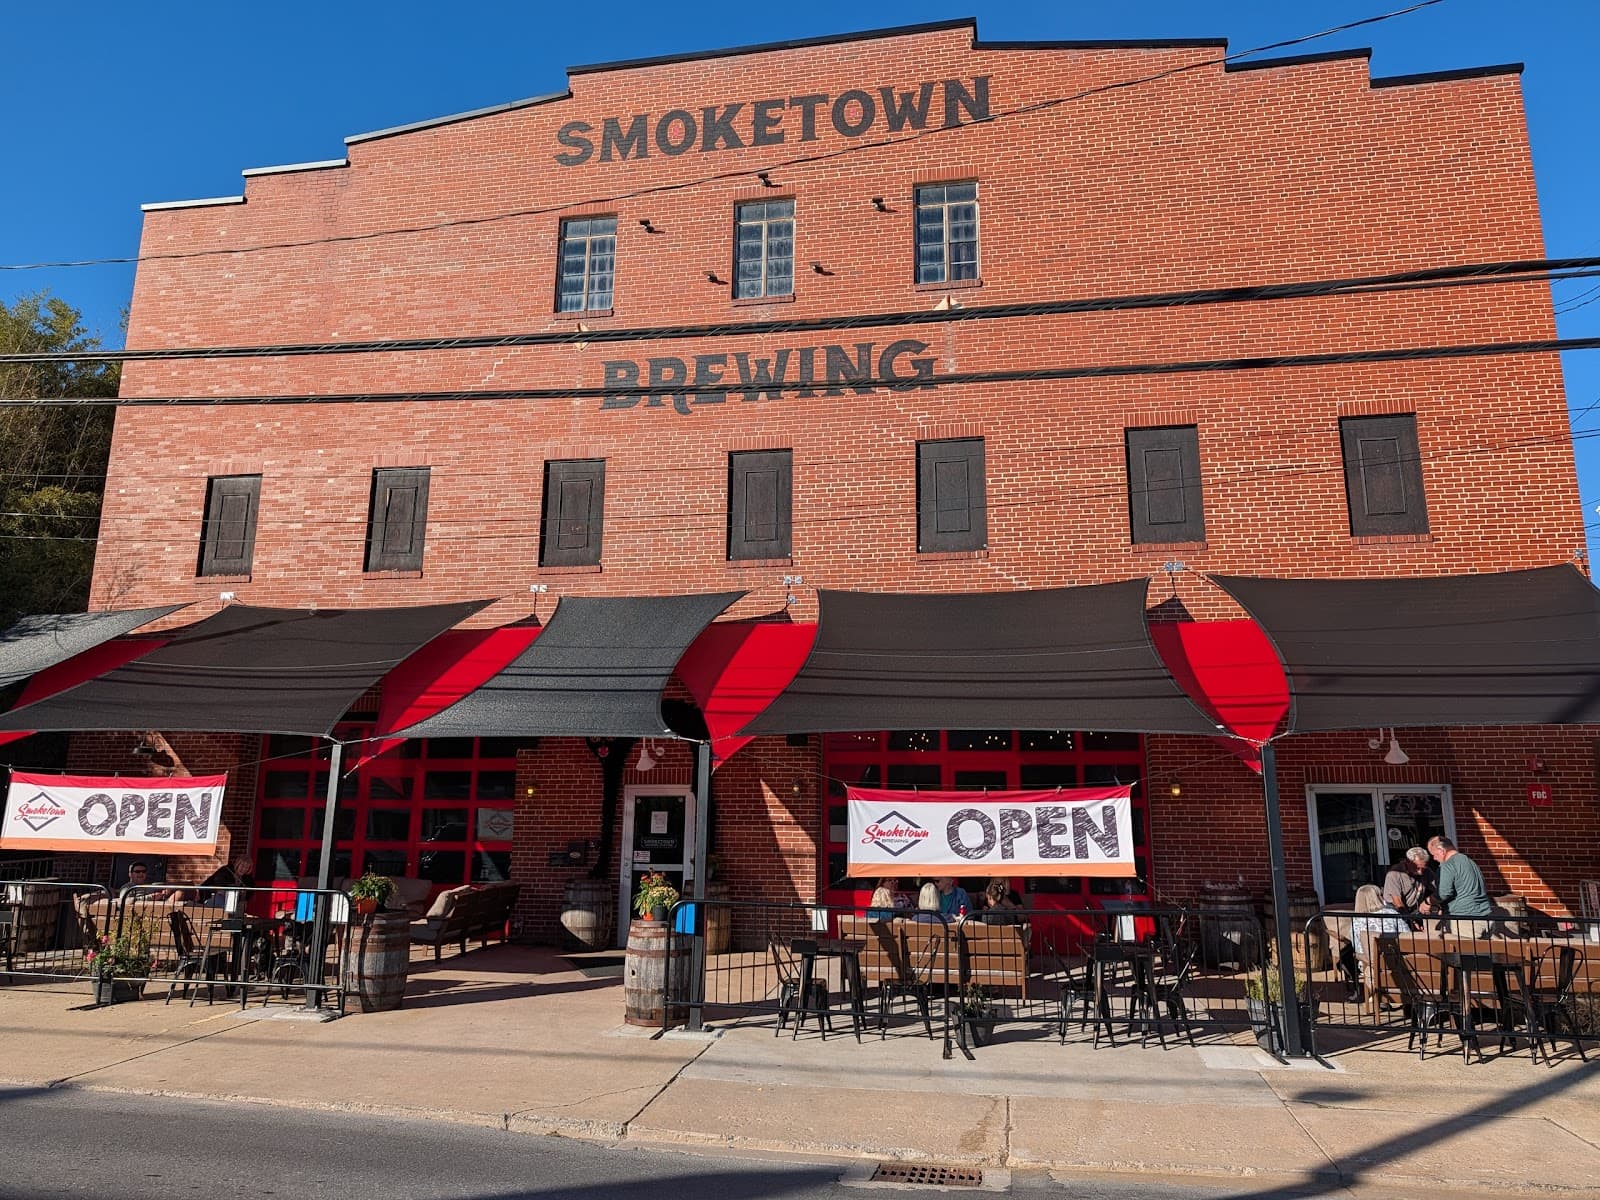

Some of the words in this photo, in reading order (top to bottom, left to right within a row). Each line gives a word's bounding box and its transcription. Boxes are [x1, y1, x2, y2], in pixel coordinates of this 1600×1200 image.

[554, 75, 992, 167] SMOKETOWN
[599, 339, 939, 415] BREWING
[14, 803, 66, 821] Smoketown
[78, 792, 213, 840] OPEN
[1531, 790, 1548, 799] FDC
[861, 823, 929, 844] Smoketown
[946, 805, 1121, 860] OPEN
